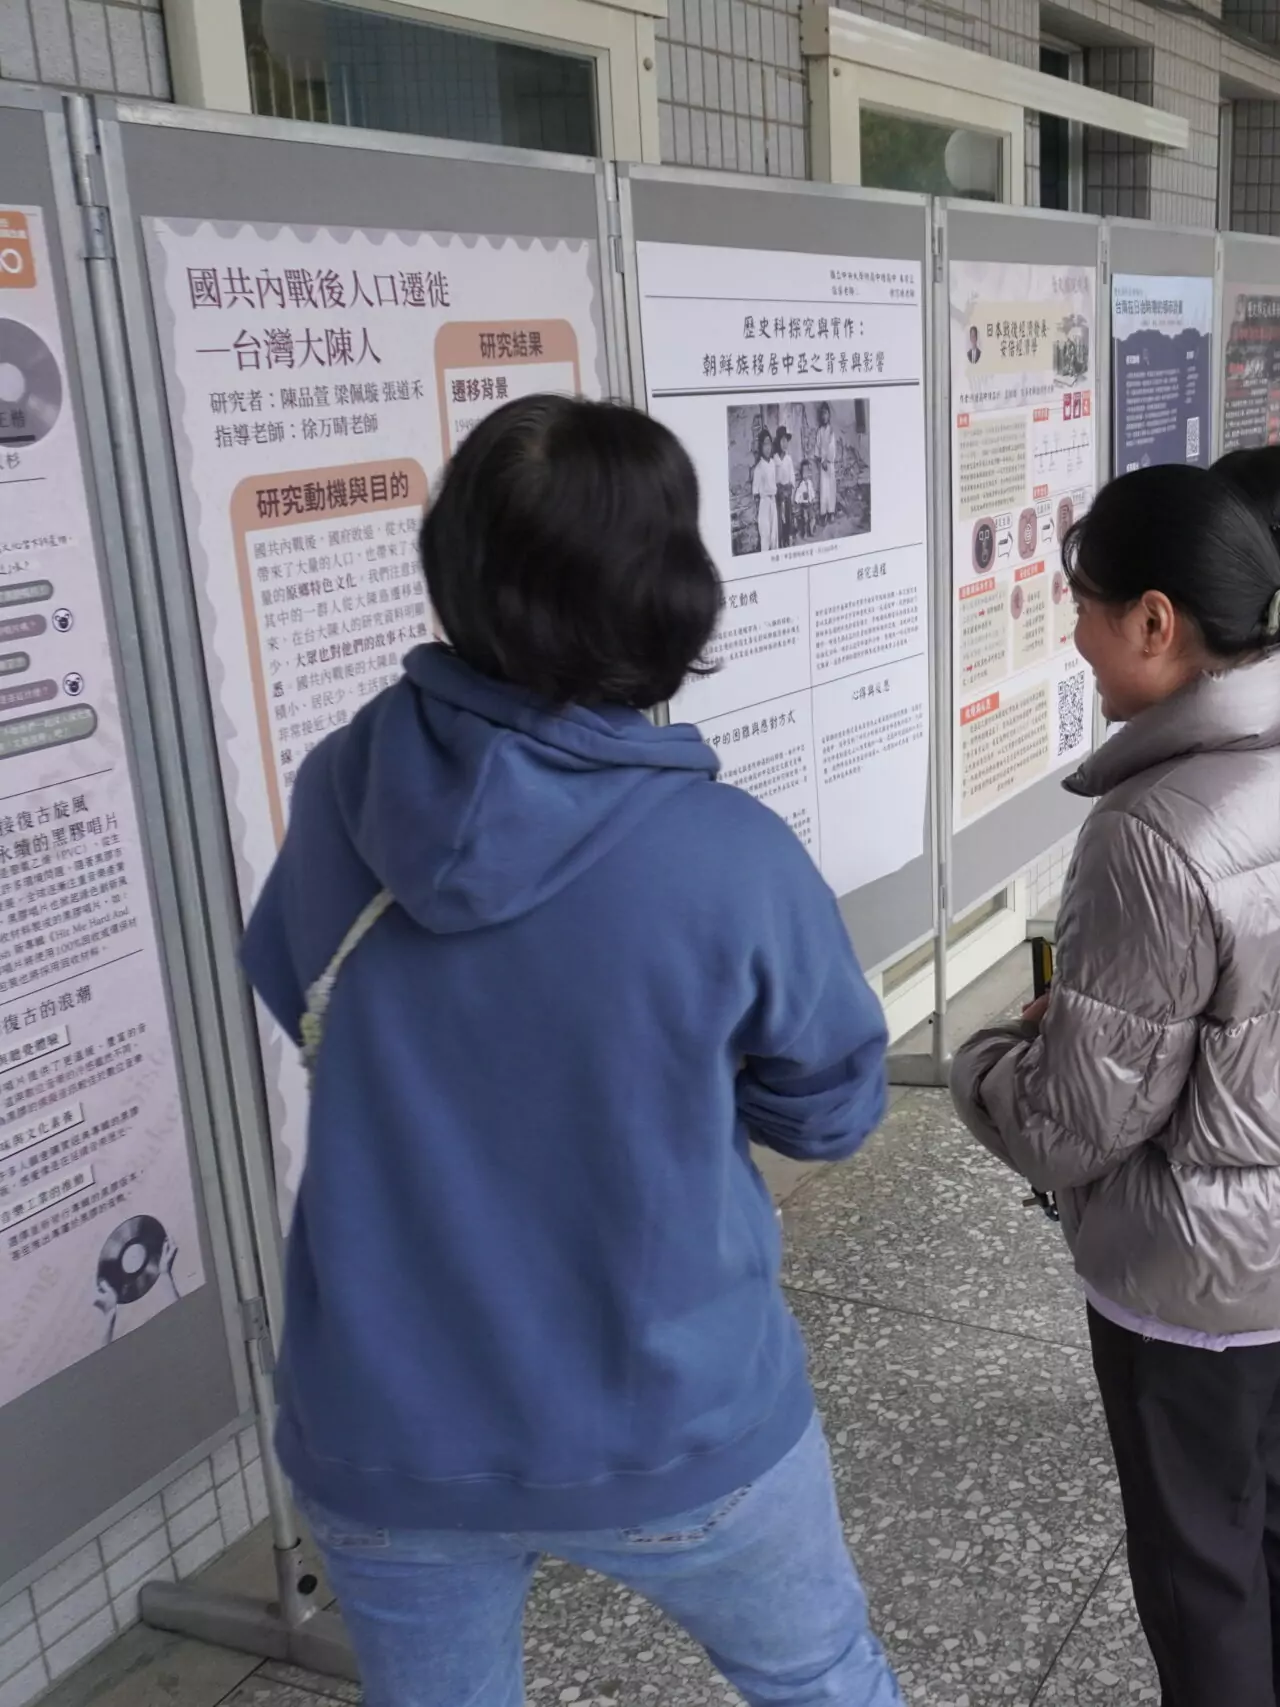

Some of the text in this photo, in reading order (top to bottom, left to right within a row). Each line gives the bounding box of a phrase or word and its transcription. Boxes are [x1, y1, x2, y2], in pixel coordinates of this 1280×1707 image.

[186, 266, 452, 310] 國共內戰後人口遷徙
[743, 316, 865, 340] 歷史科探究與實作：
[478, 331, 544, 359] 研究結果
[702, 351, 885, 378] 朝鮮族移居中亞之背景與影響
[451, 376, 509, 403] 遷移背景
[255, 470, 410, 519] 研究動機與目的
